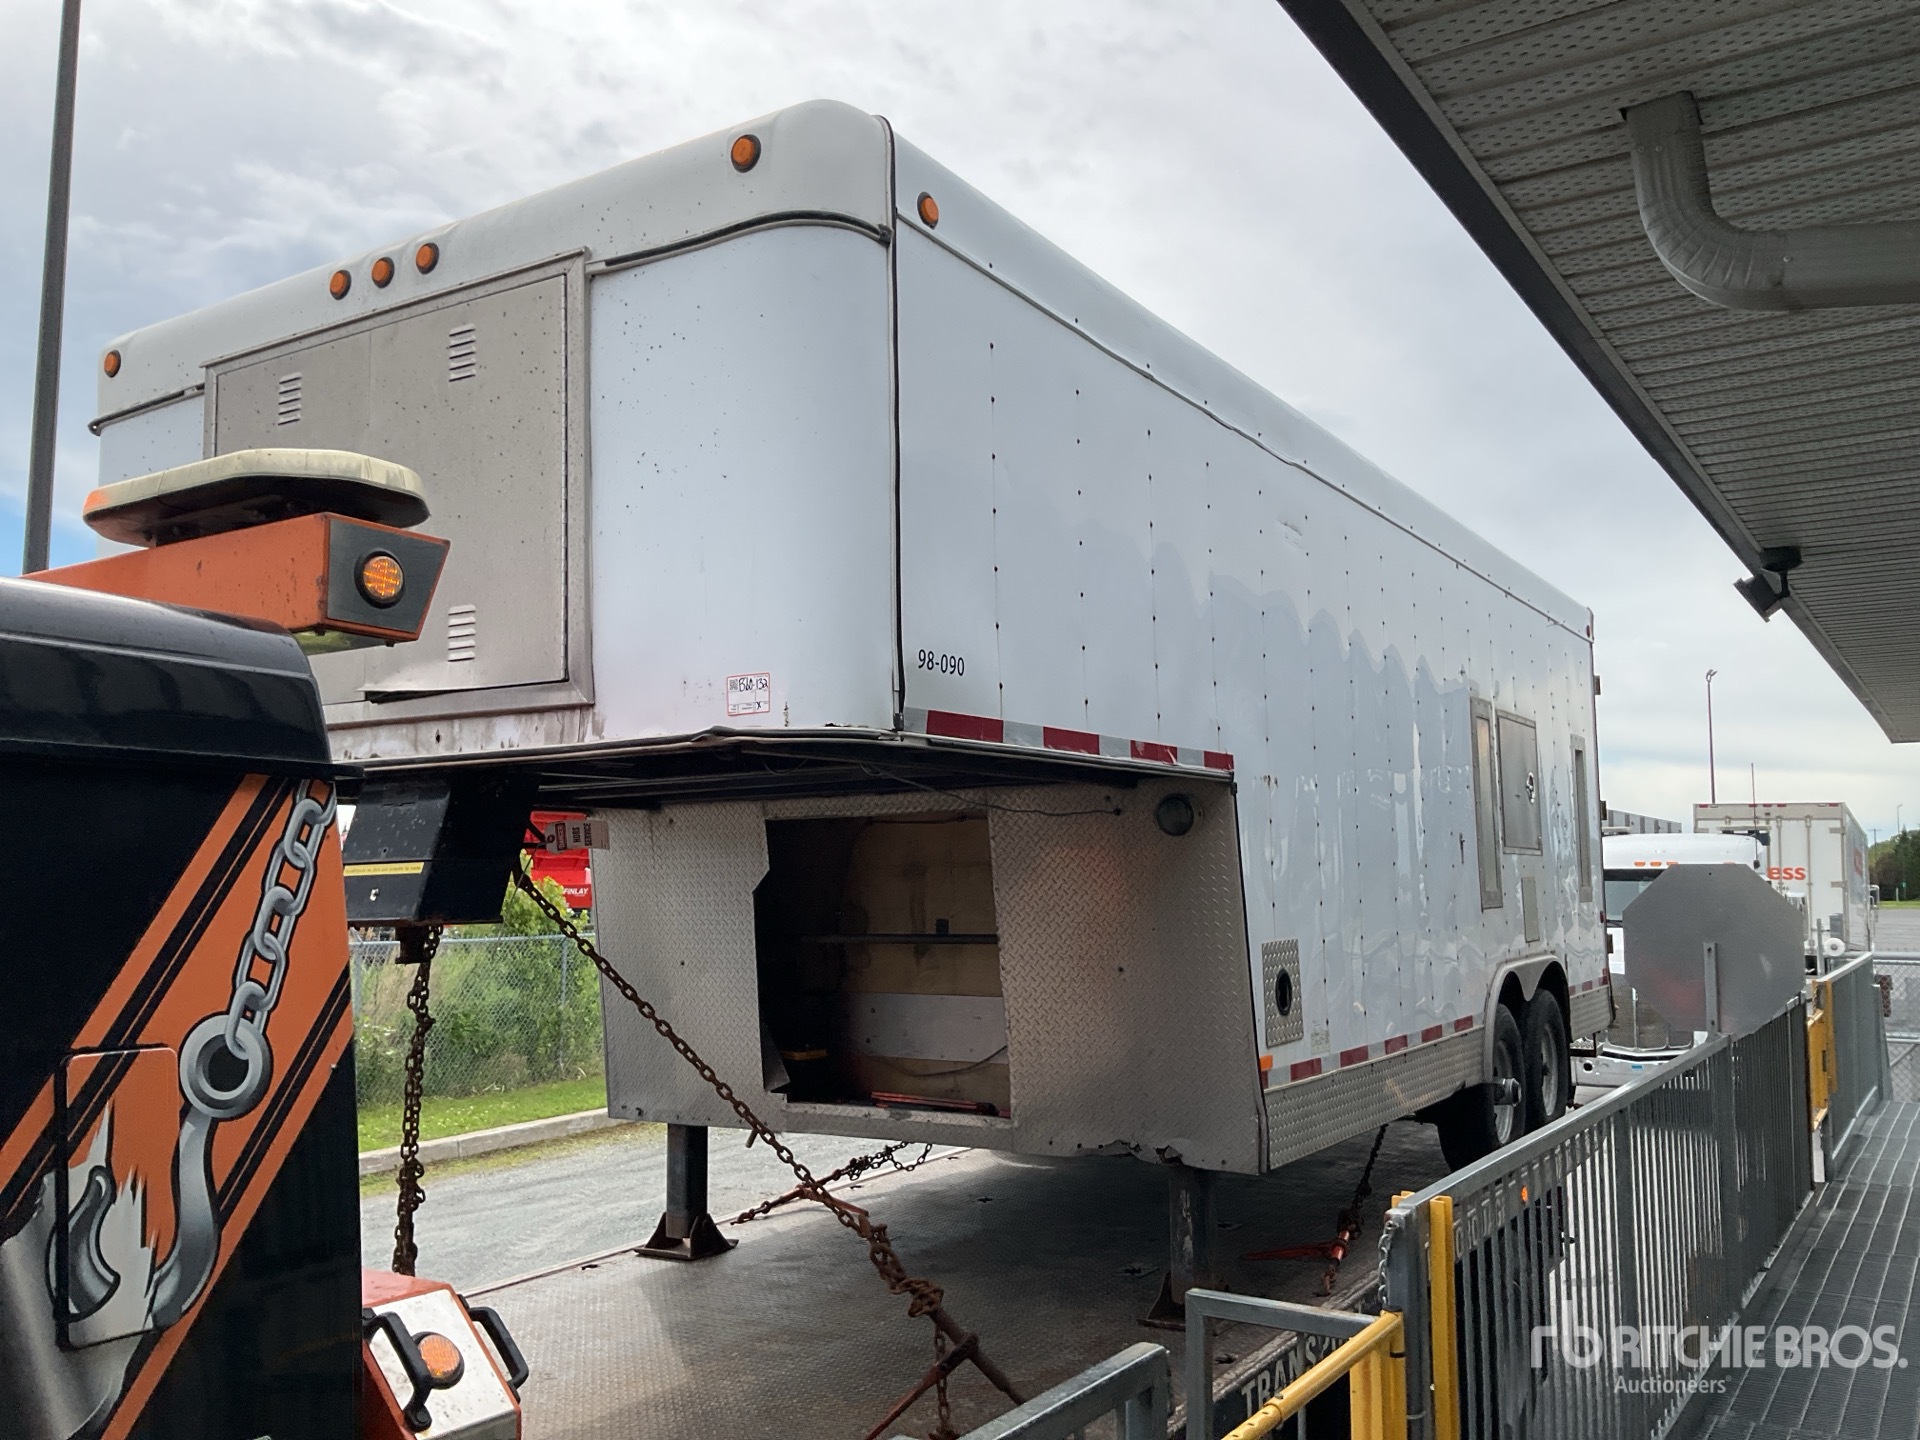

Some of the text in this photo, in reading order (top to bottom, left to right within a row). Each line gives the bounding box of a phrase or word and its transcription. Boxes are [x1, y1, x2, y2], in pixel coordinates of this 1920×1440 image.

[918, 649, 965, 676] 98-090
[572, 827, 581, 843] HORS
[584, 823, 593, 846] SERVICE
[563, 887, 589, 895] FINLAY
